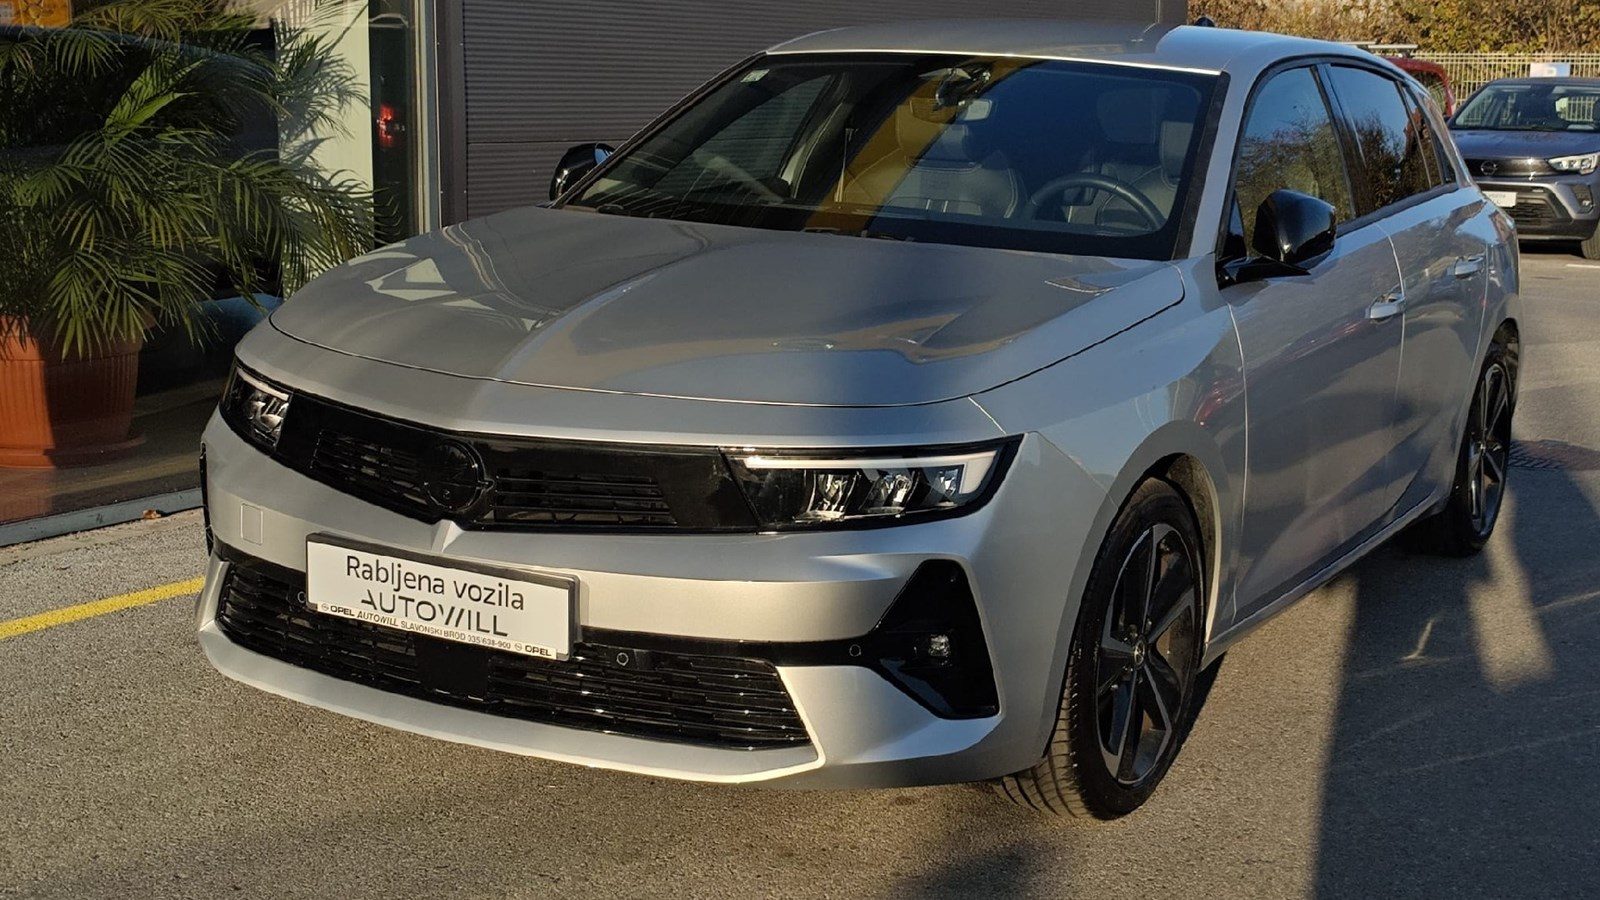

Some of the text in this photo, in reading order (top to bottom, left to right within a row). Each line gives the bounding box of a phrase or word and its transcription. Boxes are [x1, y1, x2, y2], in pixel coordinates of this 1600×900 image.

[347, 555, 525, 611] Rabljena vozila
[330, 605, 355, 617] OPEL
[357, 611, 399, 627] AUTOWILL
[401, 621, 443, 636] SLAVONSKI
[443, 629, 466, 641] BROD
[524, 645, 552, 657] OPEL
[361, 589, 509, 637] AUTOWILL
